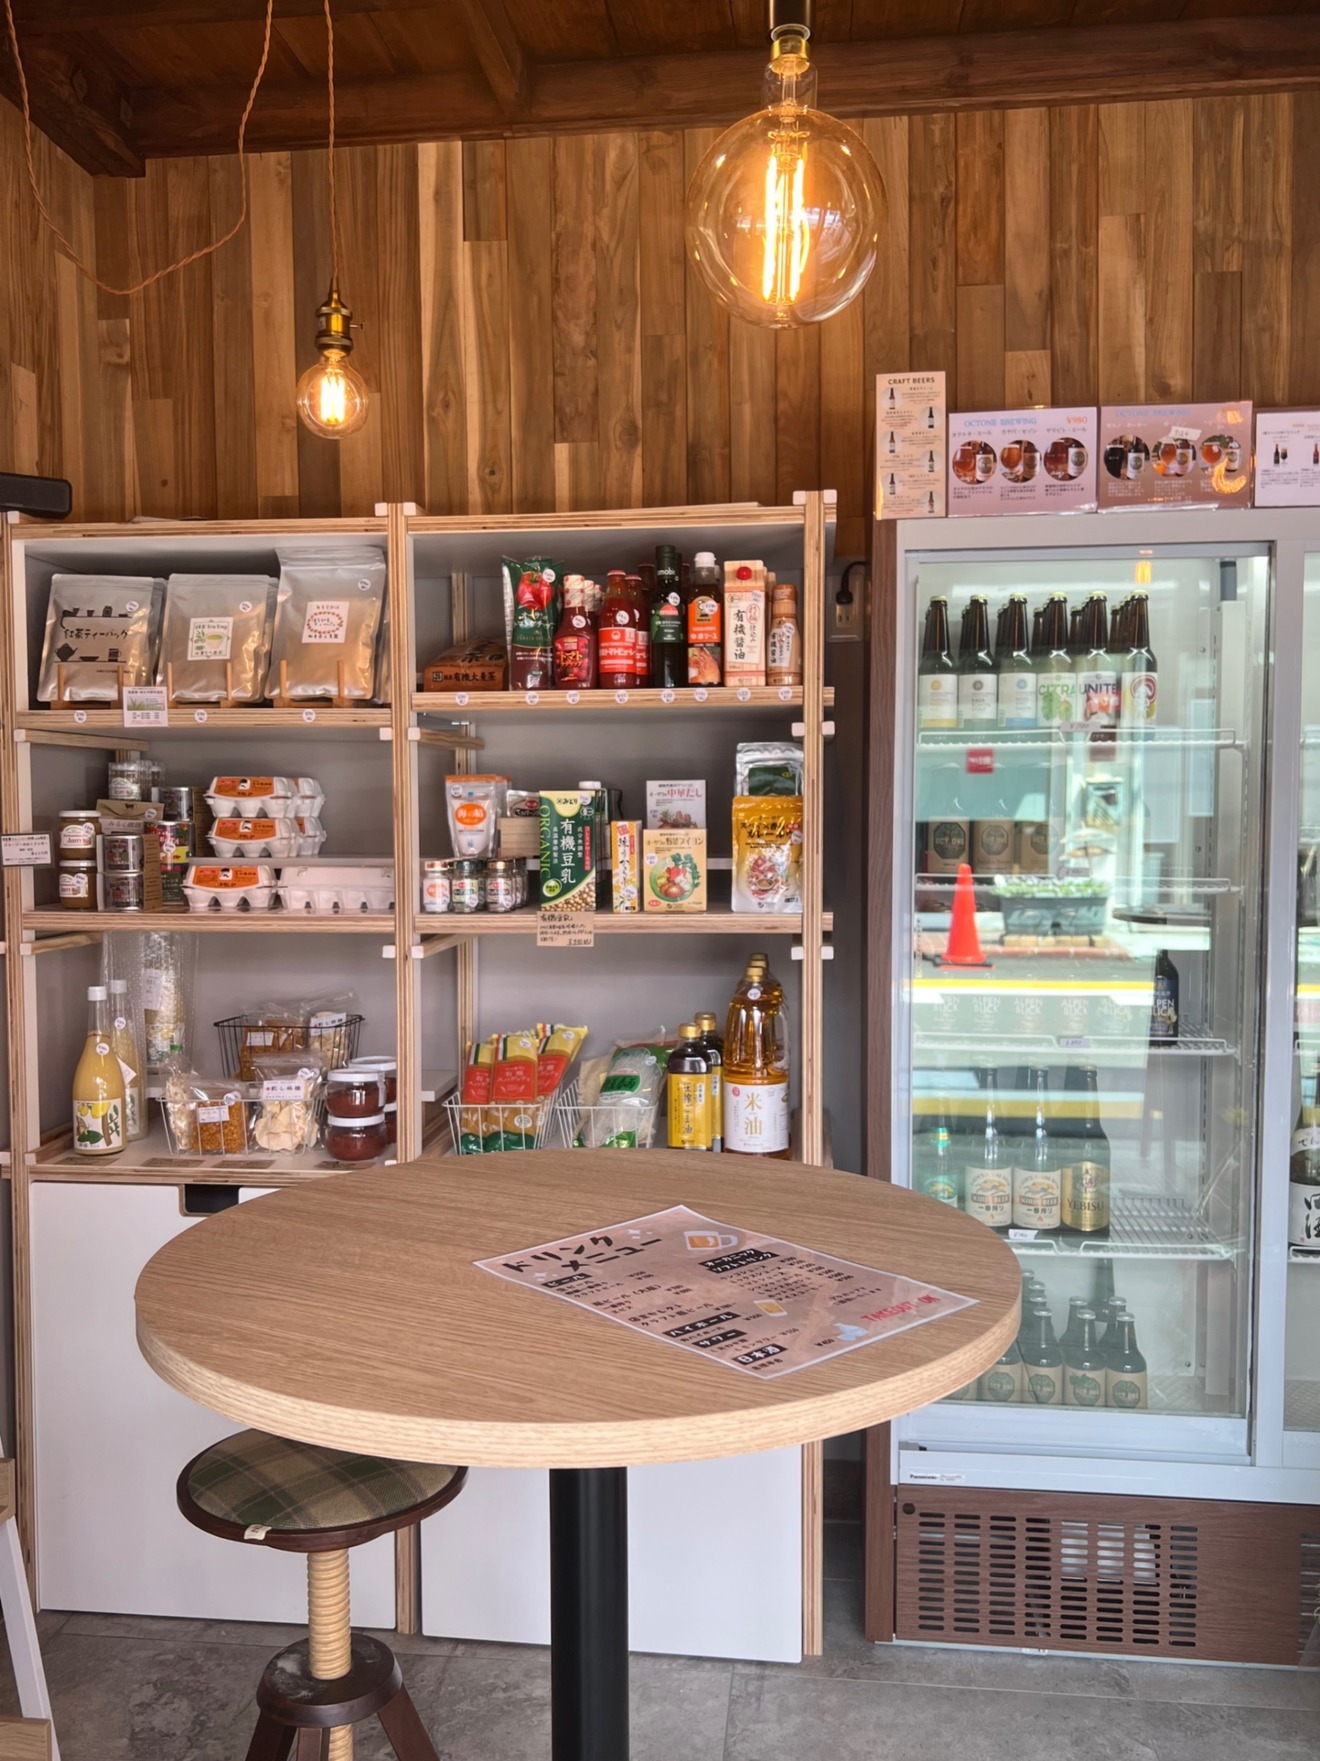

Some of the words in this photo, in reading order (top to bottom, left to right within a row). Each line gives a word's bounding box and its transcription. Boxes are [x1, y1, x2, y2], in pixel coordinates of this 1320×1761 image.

[964, 419, 997, 427] OCTONE
[1000, 417, 1037, 426] BREWING
[1066, 416, 1088, 424] ¥980
[733, 610, 746, 660] 有機醤油
[1038, 685, 1076, 696] CITRA
[540, 805, 551, 879] ORGANIC
[560, 819, 577, 884] 有機豆乳
[744, 1092, 762, 1136] 米油
[1066, 1199, 1104, 1211] YEBISU
[501, 1235, 613, 1272] ドリンク
[560, 1238, 661, 1271] メニュー
[704, 1249, 754, 1266] オーガニック
[712, 1253, 771, 1271] ソフトドリンク
[547, 1275, 584, 1286] ビール
[859, 1301, 918, 1321] TAKEOUT
[917, 1294, 940, 1303] OK
[669, 1314, 732, 1336] ハイボール
[699, 1332, 735, 1345] サワー
[737, 1345, 779, 1362] 日本酒
